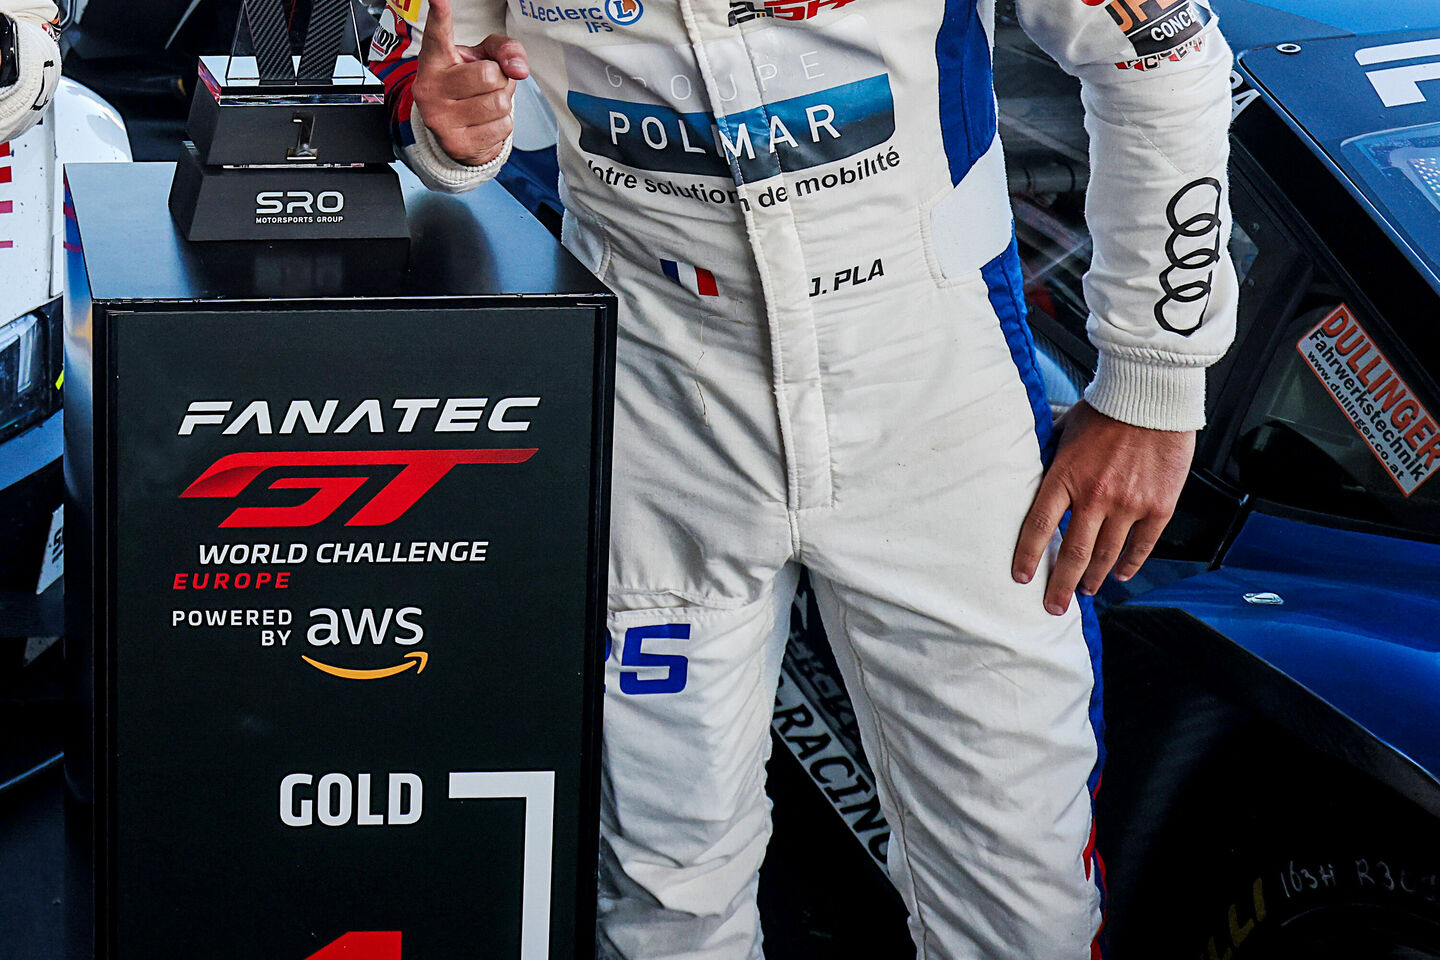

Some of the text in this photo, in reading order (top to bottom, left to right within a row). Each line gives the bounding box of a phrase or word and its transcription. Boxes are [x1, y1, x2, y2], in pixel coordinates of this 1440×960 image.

[586, 21, 614, 34] IFS
[605, 49, 826, 103] GOUPE
[608, 103, 842, 167] POLMAR
[587, 145, 901, 212] otre solution de mobilité
[255, 191, 345, 214] SRO
[255, 215, 344, 224] MOTORSPORTS GROUP
[808, 257, 885, 298] J. PLA
[1308, 327, 1427, 482] Fahrwerkstechnik
[1321, 308, 1440, 472] DULLINGER
[177, 396, 541, 436] FANATEC
[1306, 351, 1404, 481] www.dullinger.co.at
[198, 541, 489, 565] WORLD CHALLENGE
[171, 572, 291, 591] EUROPE
[171, 608, 293, 628] POWERED
[261, 630, 292, 646] BY
[306, 605, 424, 646] aws
[604, 623, 691, 695] 5
[278, 772, 423, 828] GOLD
